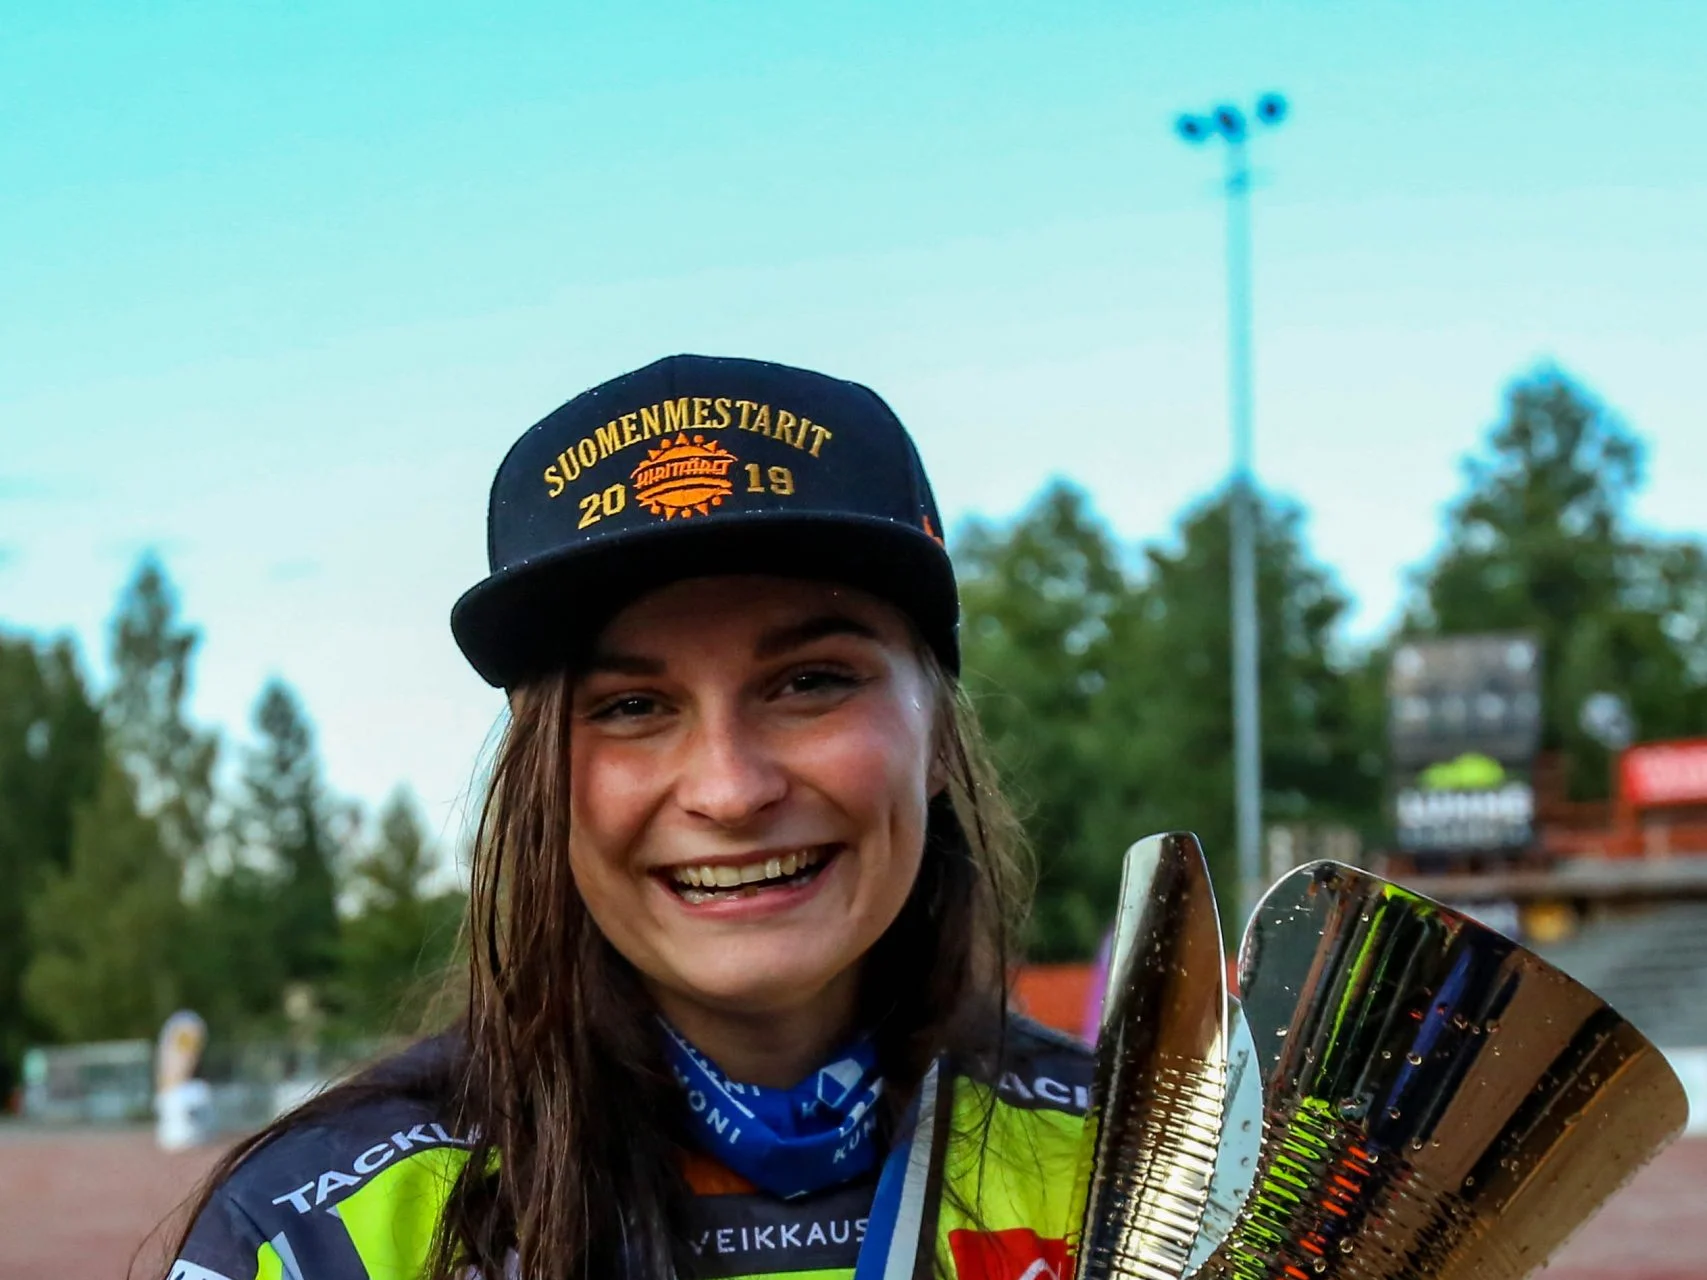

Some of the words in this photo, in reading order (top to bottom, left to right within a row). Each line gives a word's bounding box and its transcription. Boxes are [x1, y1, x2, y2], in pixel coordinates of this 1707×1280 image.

[543, 397, 833, 499] SUOMENMESTARIT
[744, 462, 796, 496] 19
[577, 482, 627, 530] 20
